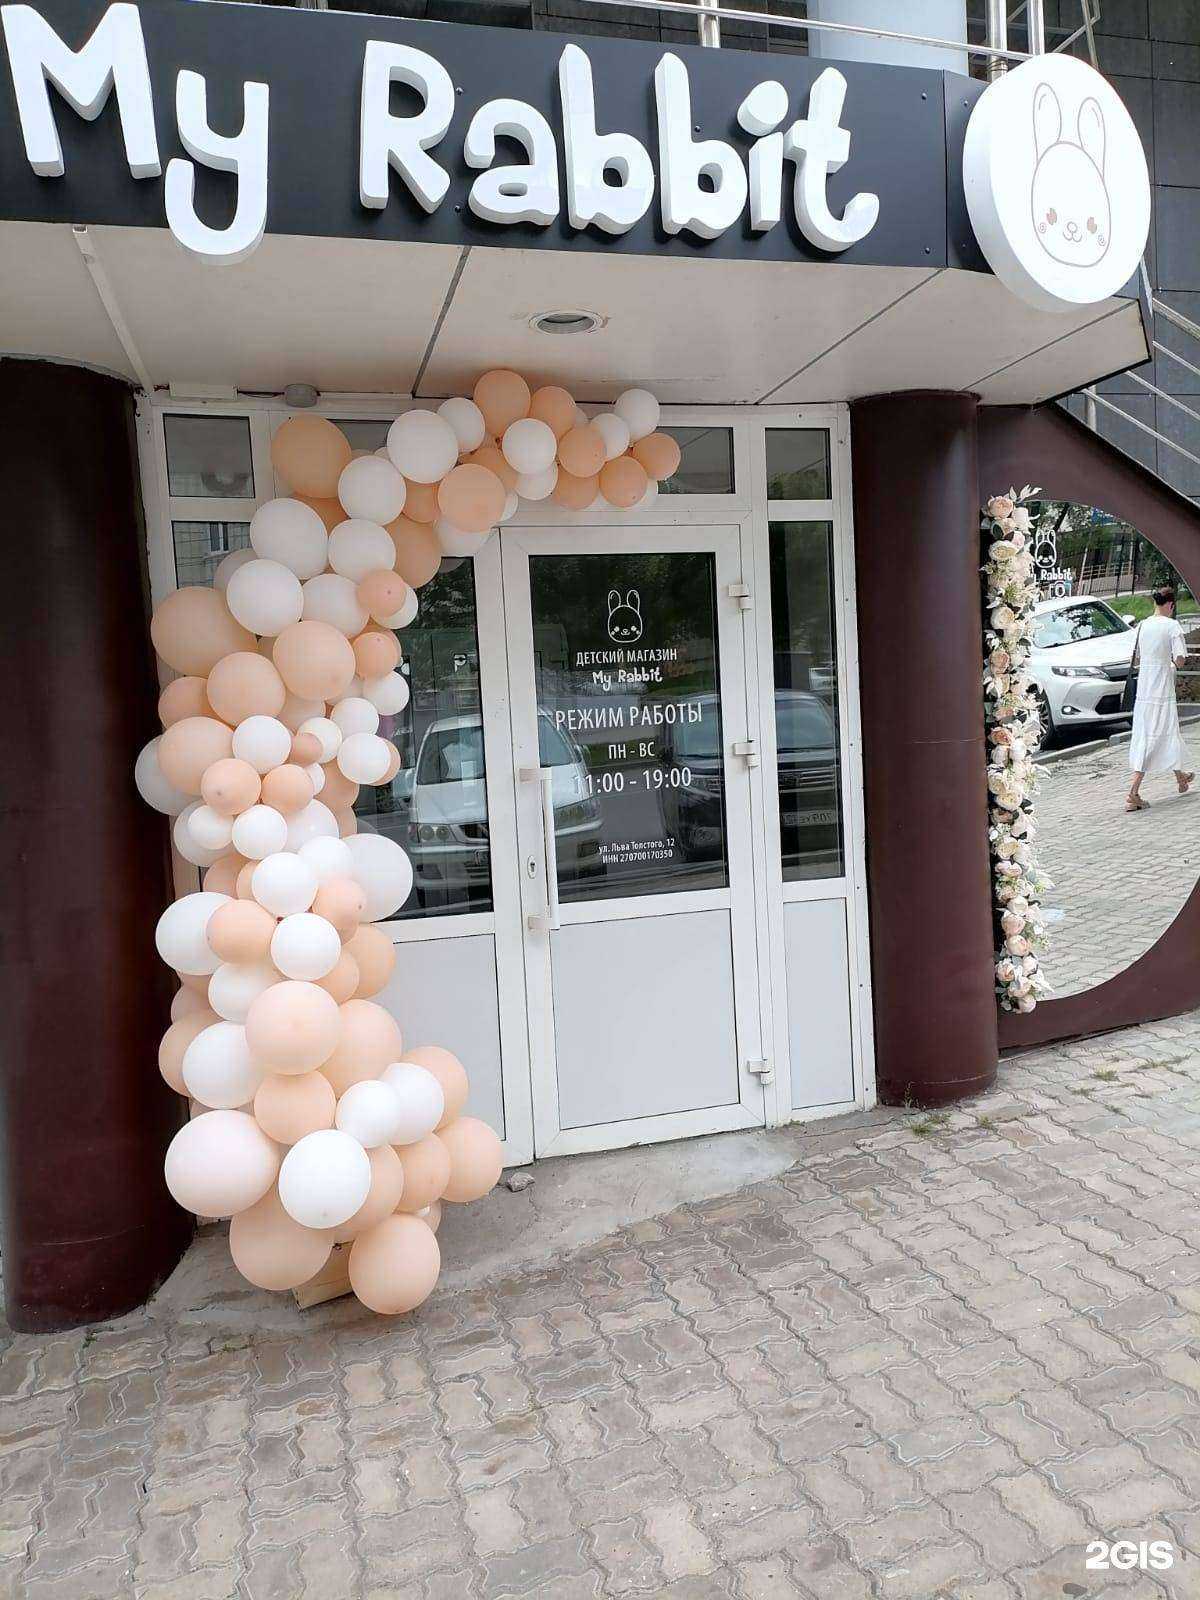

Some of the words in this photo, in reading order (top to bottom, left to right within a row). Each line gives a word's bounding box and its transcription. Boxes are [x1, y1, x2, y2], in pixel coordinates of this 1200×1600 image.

[0, 3, 270, 265] My
[359, 42, 880, 253] Rabbit
[1040, 567, 1073, 581] Rabbit
[576, 649, 624, 667] ДЕТСКИЙ
[627, 648, 678, 664] МАГАЗИН
[592, 671, 612, 691] My
[618, 667, 663, 684] Rabbit
[555, 708, 624, 731] РЕЖИМ
[630, 702, 703, 726] РАБОТЫ
[608, 744, 627, 760] ПН
[639, 741, 656, 758] ВС
[574, 772, 624, 795] 11:00
[642, 766, 692, 789] 19:00
[598, 846, 610, 855] ул.
[611, 842, 630, 852] Льва
[631, 840, 665, 850] Толстого,
[666, 838, 676, 847] 12
[602, 854, 619, 864] ИНН
[620, 849, 673, 863] 270700170350
